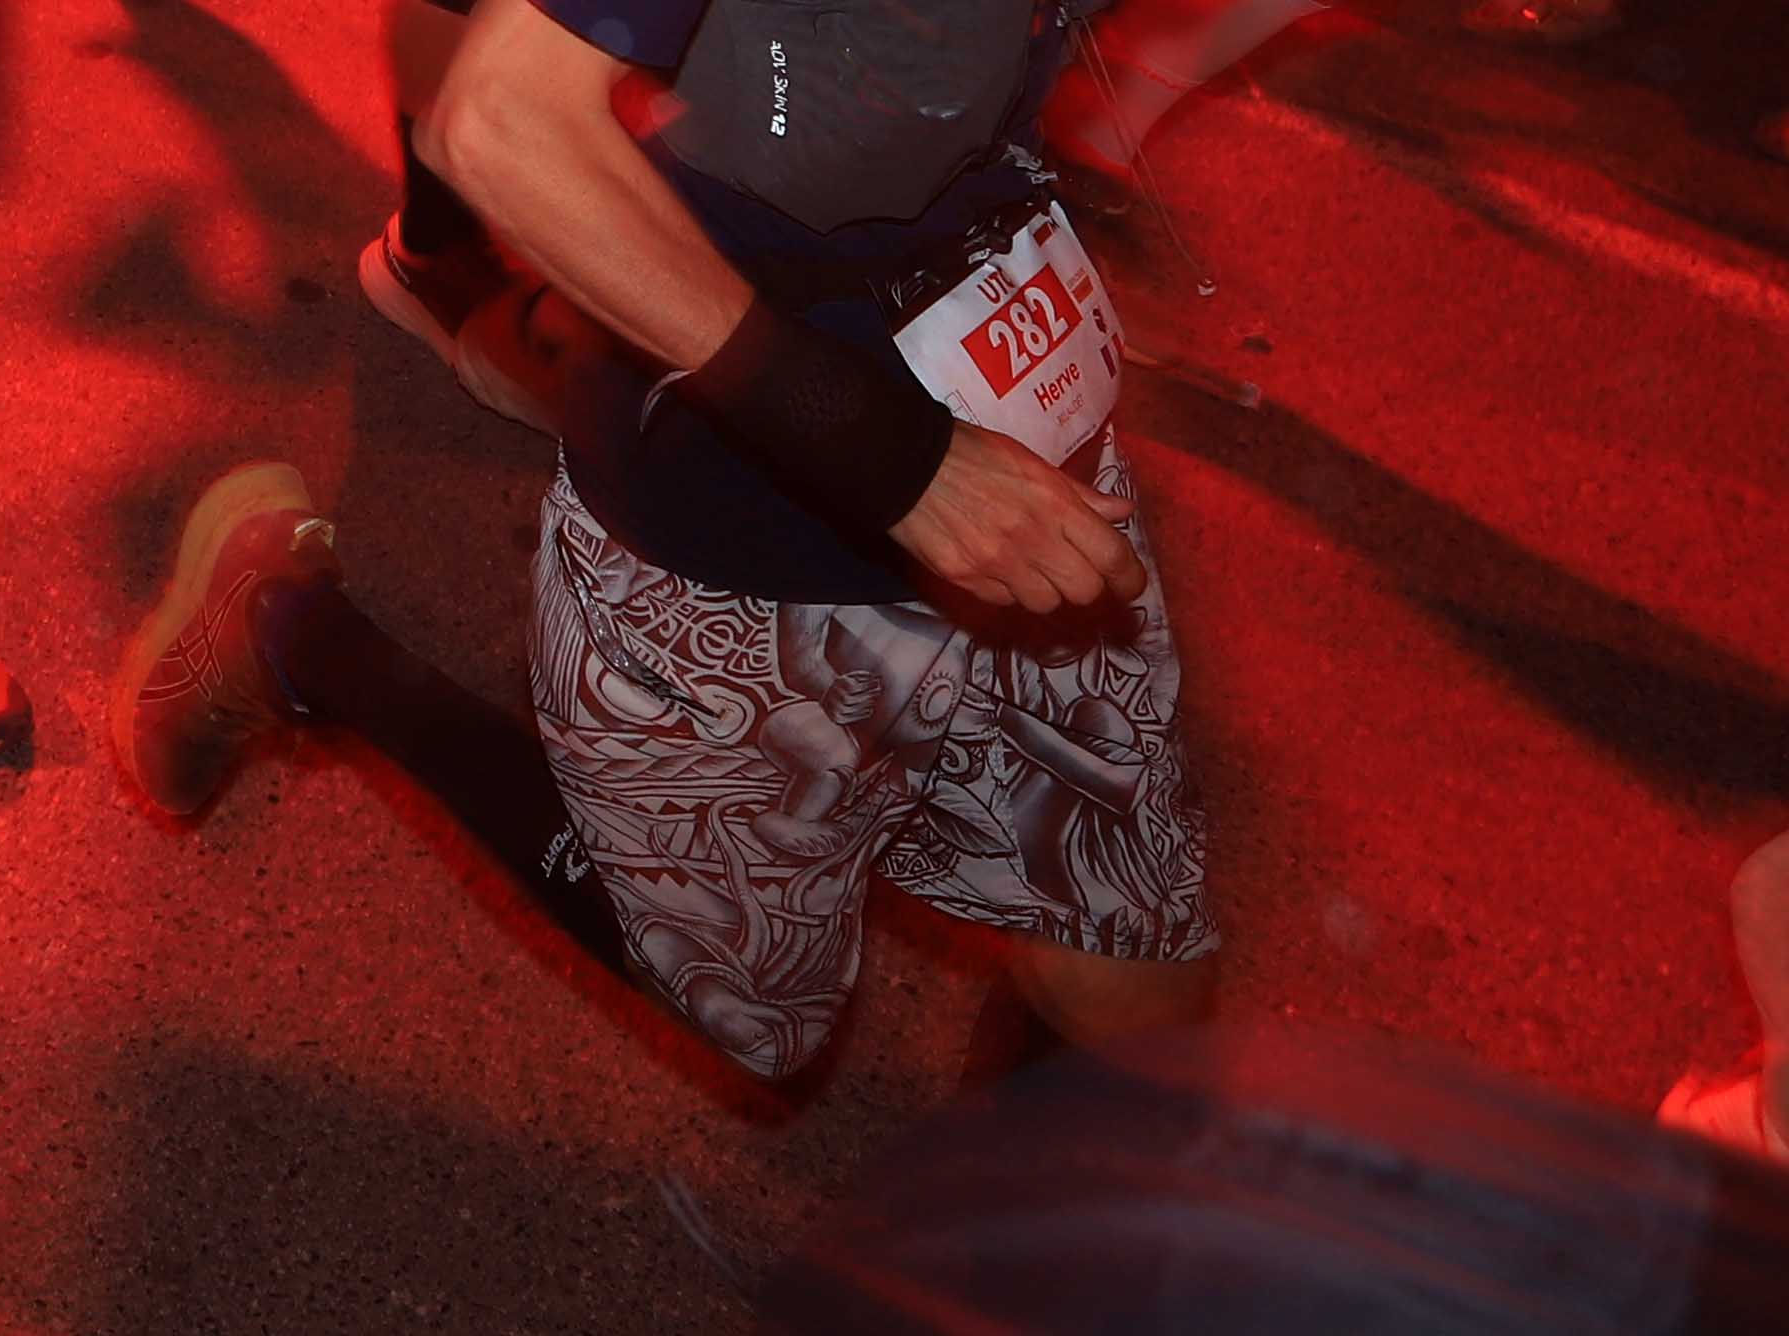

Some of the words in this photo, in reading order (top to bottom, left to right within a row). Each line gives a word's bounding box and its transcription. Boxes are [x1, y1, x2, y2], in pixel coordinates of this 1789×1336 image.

[773, 73, 789, 114] SKIN
[769, 114, 787, 136] 12
[988, 285, 1069, 379] 282
[1033, 363, 1081, 413] Herve
